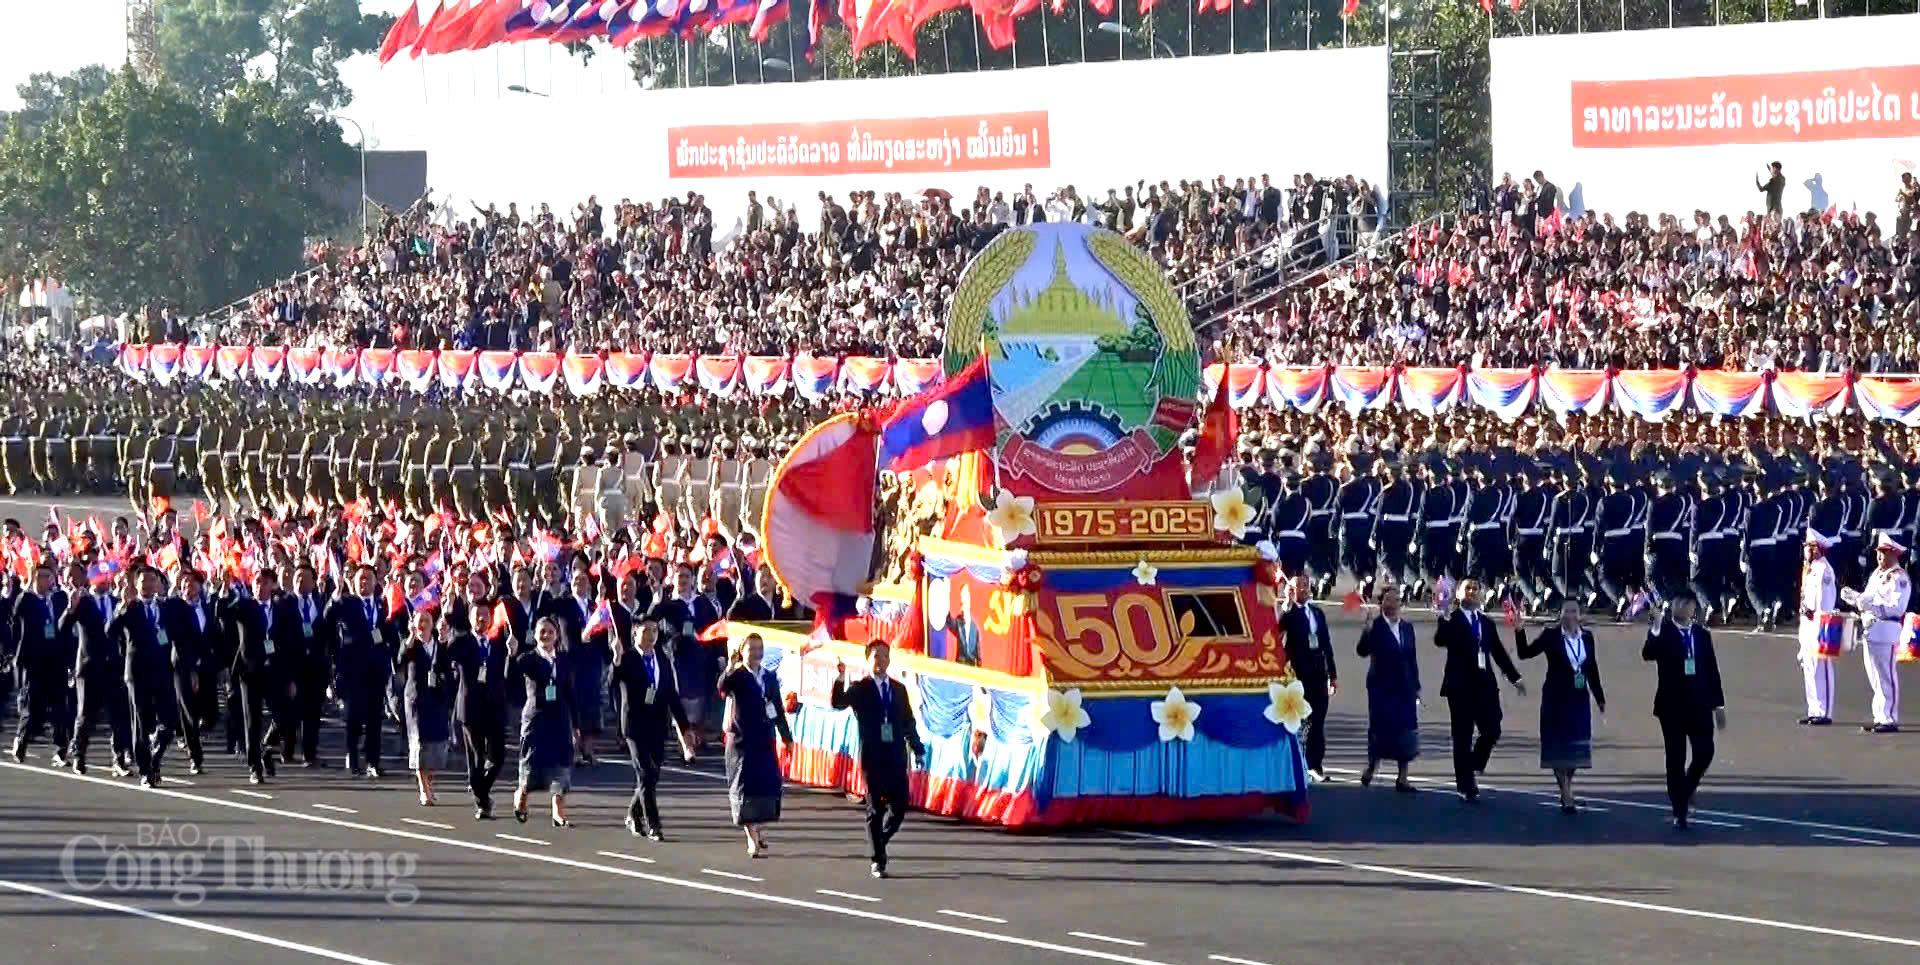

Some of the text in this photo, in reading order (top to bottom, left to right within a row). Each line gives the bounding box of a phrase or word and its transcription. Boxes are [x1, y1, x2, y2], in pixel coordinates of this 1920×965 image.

[1584, 91, 1742, 133] ສາທາລະນະລັດ
[1043, 507, 1206, 536] 1975-2025
[1056, 593, 1173, 667] 50
